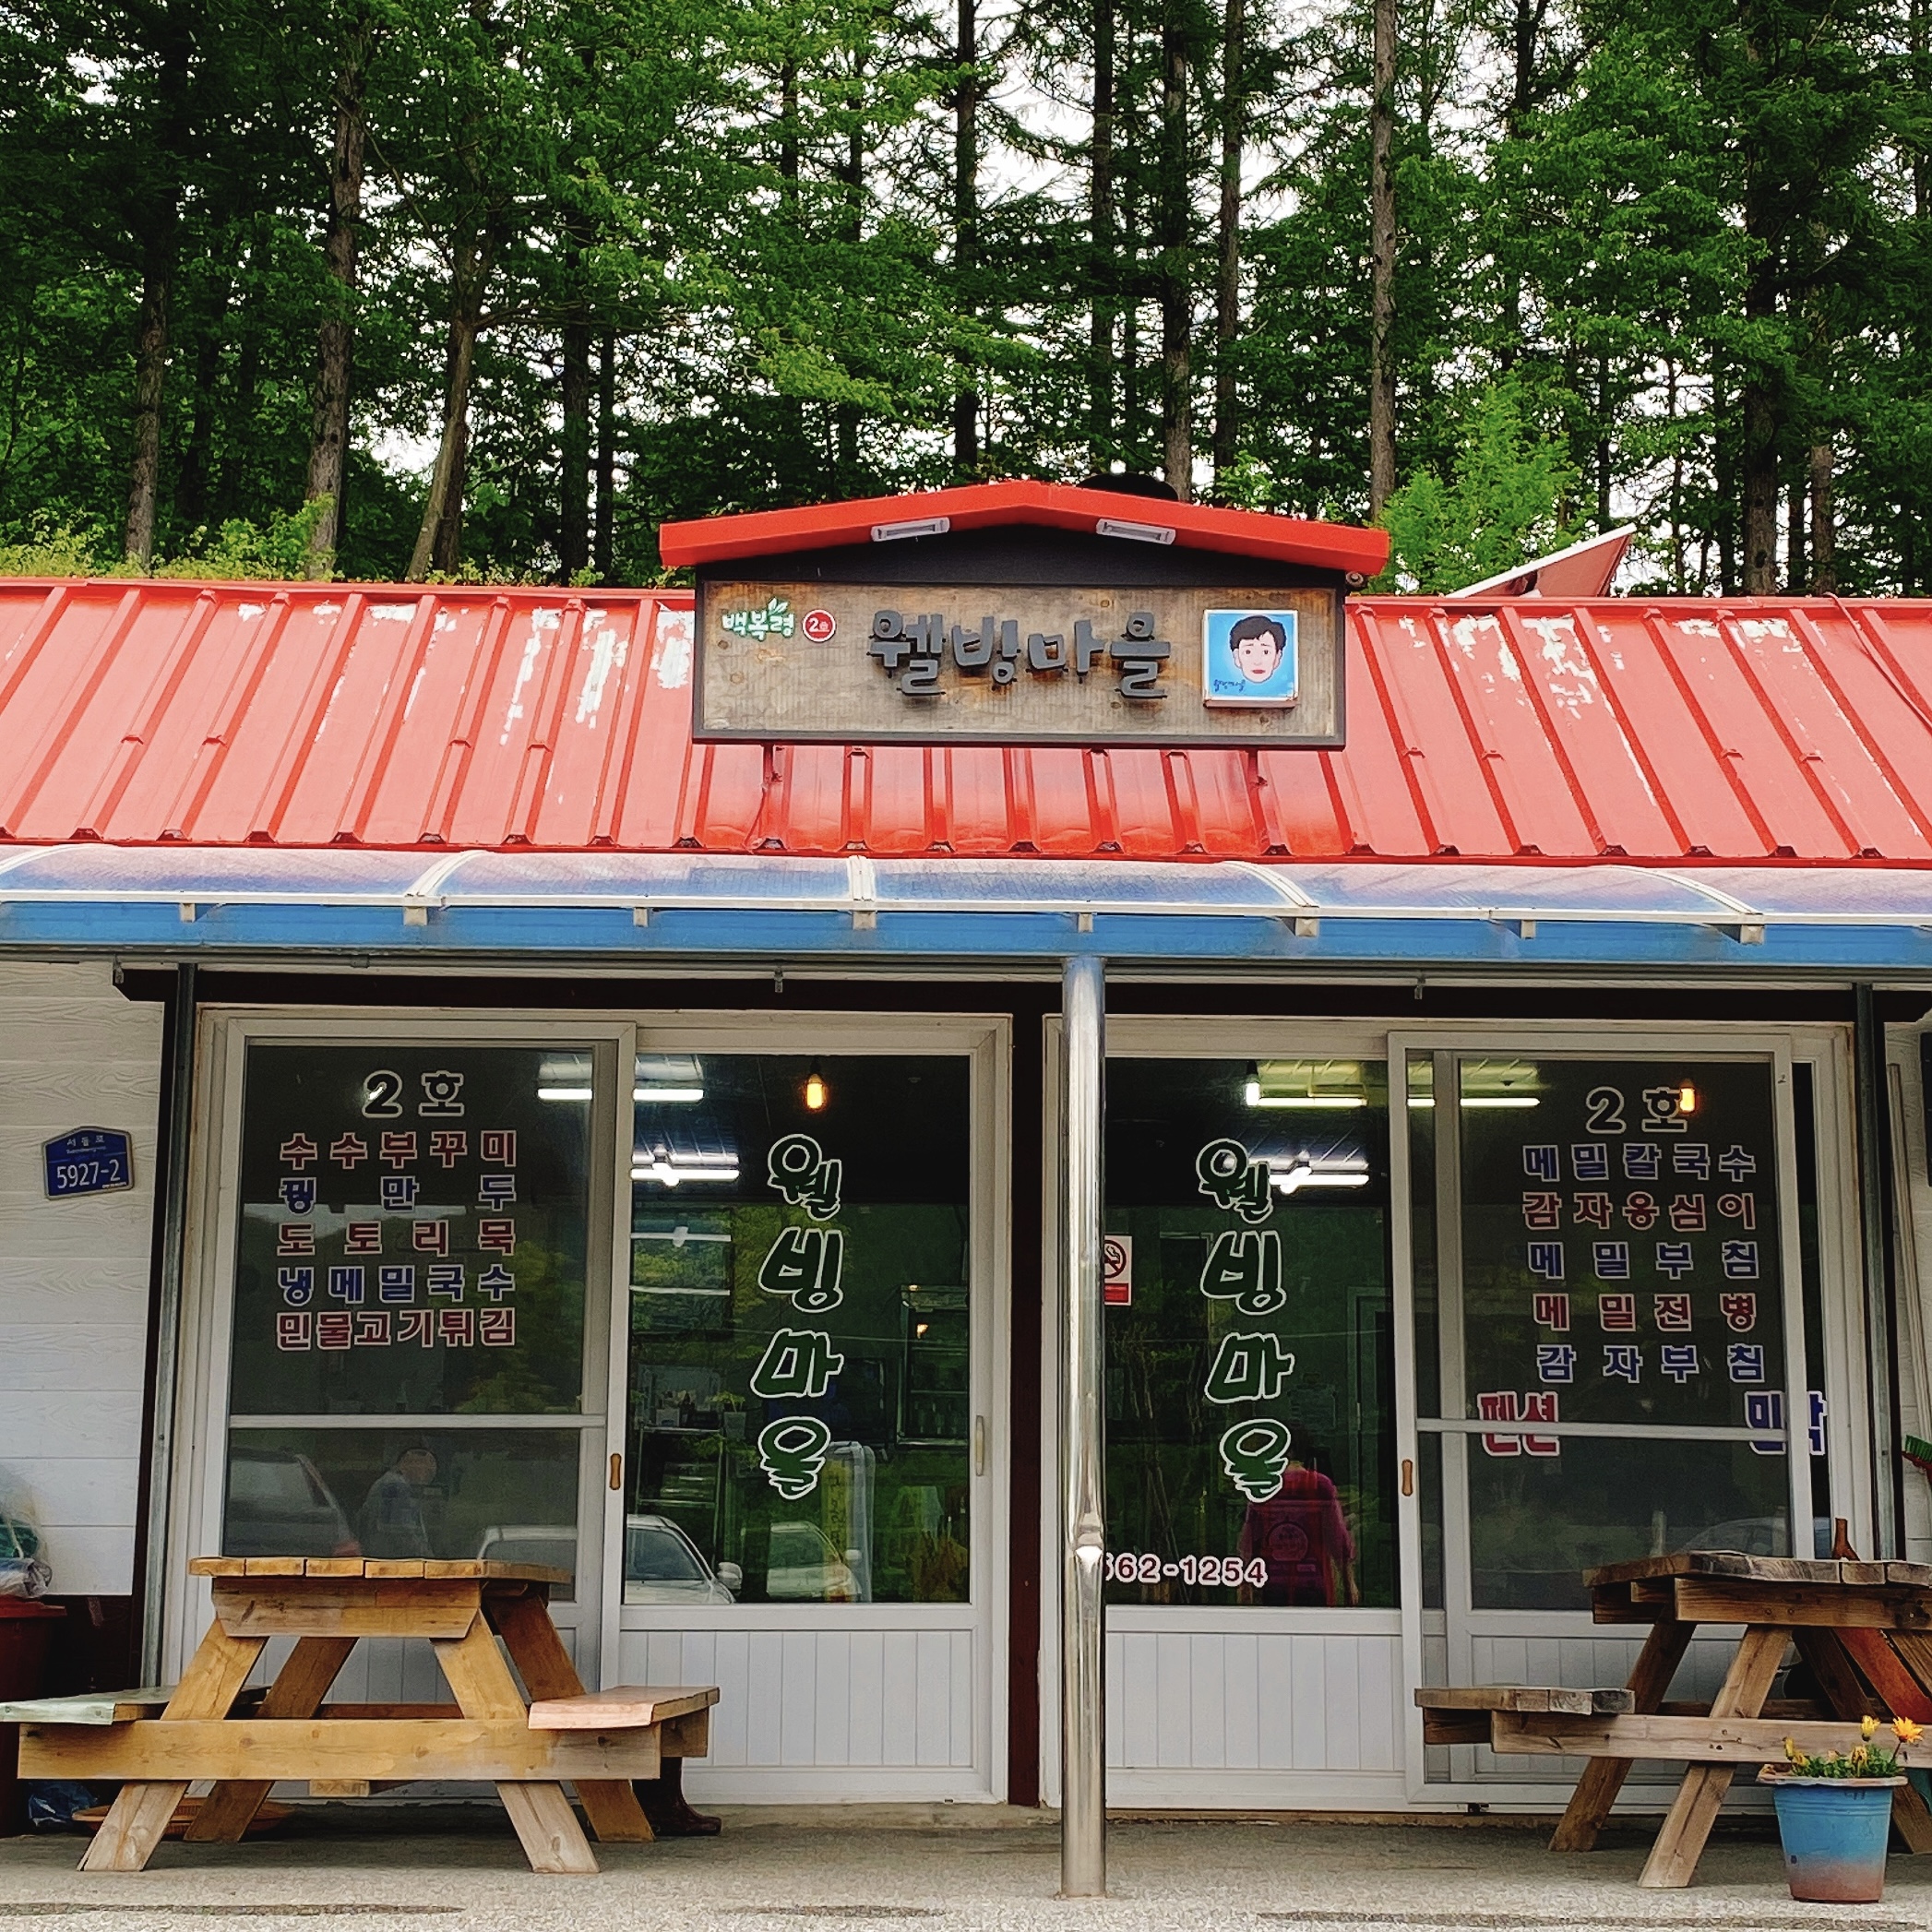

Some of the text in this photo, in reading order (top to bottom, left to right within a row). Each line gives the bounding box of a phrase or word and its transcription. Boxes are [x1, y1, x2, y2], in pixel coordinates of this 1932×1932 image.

[722, 610, 794, 640] 백복령
[867, 609, 1172, 699] 웰빙마을
[280, 1129, 517, 1170] 수수부꾸미
[1522, 1142, 1756, 1182] 메밀칼국수
[57, 1159, 121, 1188] 5927-2
[1522, 1191, 1756, 1232] 감자옹심이
[277, 1219, 515, 1257] 도토리묵
[1527, 1240, 1759, 1280] 메밀부침
[278, 1264, 515, 1306] 냉메밀국수
[277, 1307, 516, 1351] 민물고기튀김
[750, 1133, 843, 1500] 웰빙마을
[1195, 1138, 1294, 1503] 웰빙마을
[1532, 1293, 1756, 1332] 메밀전병
[1537, 1343, 1765, 1384] 감자부침
[1477, 1390, 1559, 1457] 펜션
